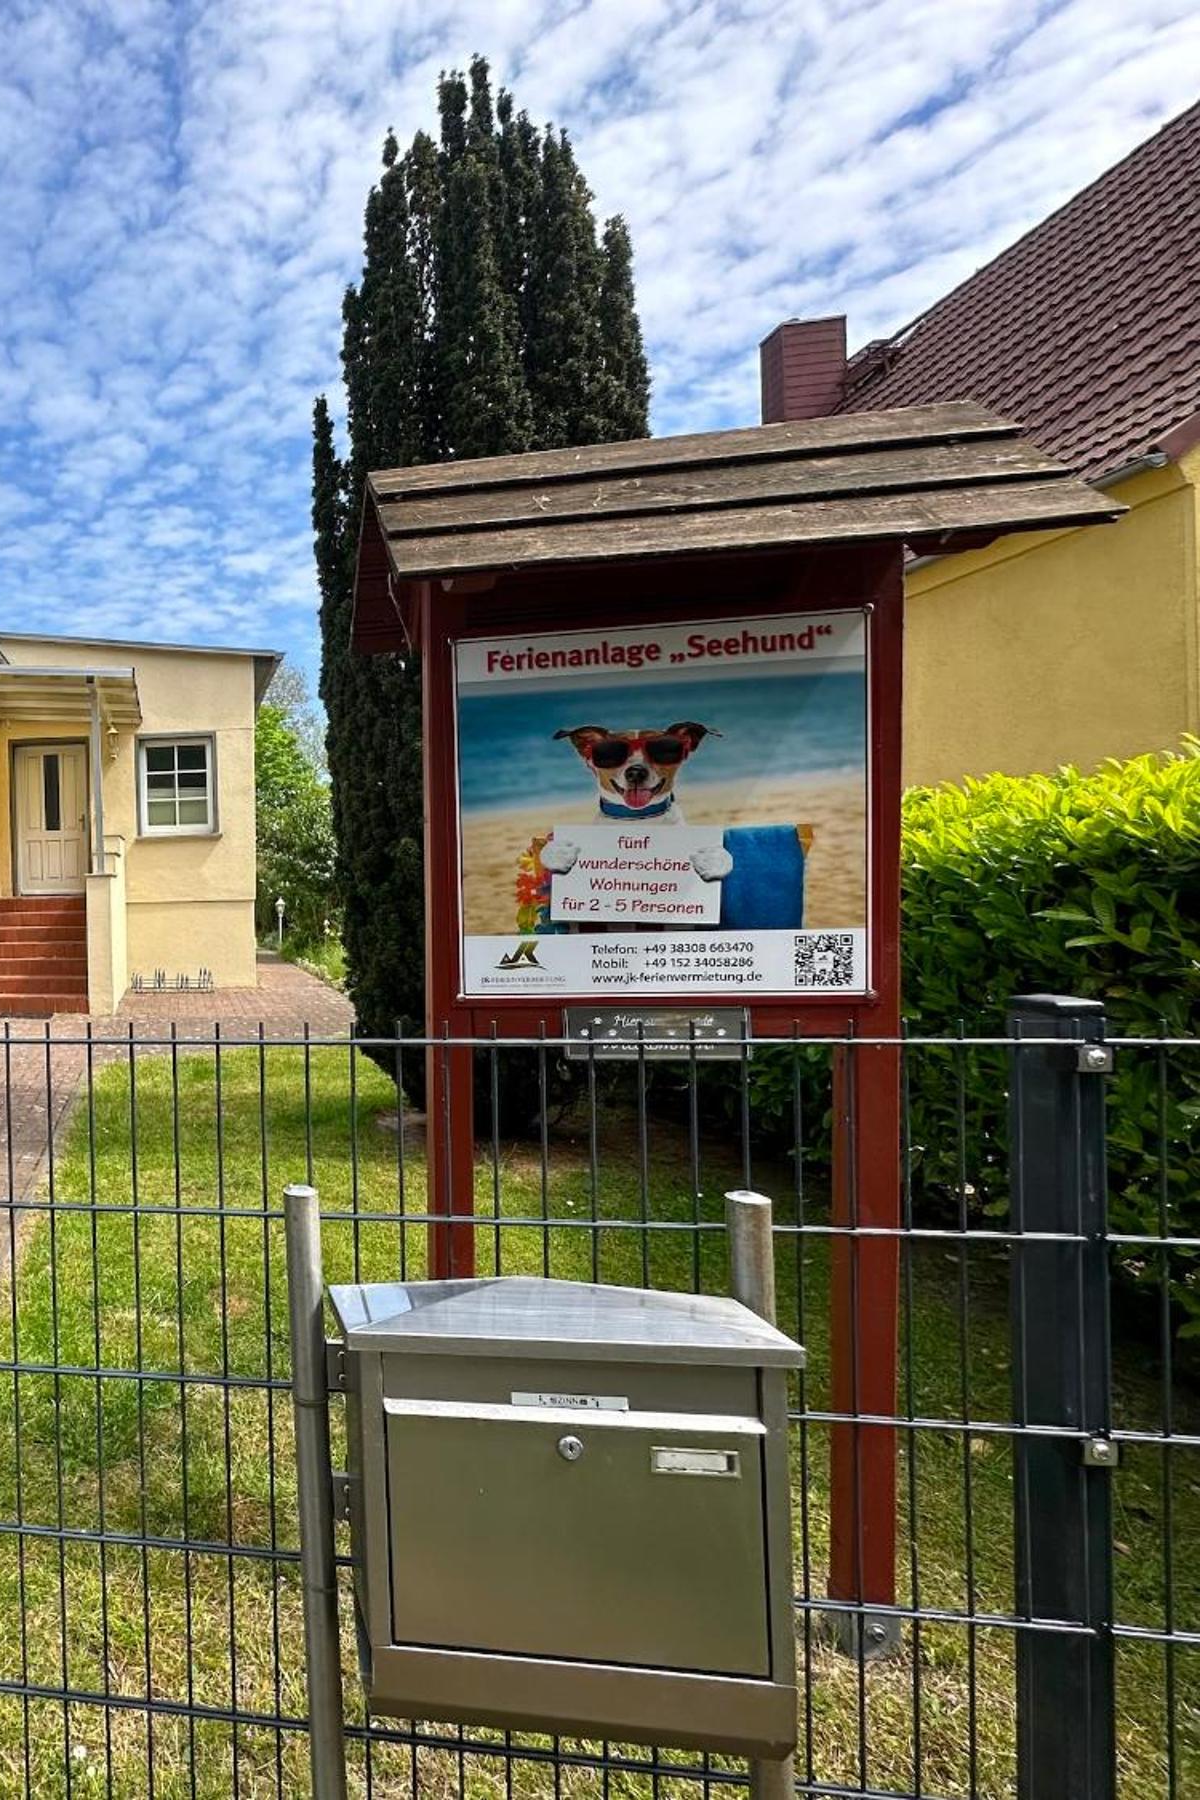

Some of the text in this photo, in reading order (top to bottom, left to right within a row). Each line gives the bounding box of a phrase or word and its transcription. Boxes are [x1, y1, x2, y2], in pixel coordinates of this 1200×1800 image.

[487, 624, 833, 673] Ferienanlage „Seehund“
[617, 835, 651, 850] fünf
[578, 857, 691, 872] wunderschöne
[590, 877, 678, 895] Wohnungen
[562, 897, 585, 911] für
[589, 898, 600, 912] 2
[615, 899, 627, 912] 5
[631, 899, 704, 914] Personen
[591, 942, 754, 955] Telefon: +49 38308 663470
[591, 957, 754, 969] Mobil: +49 152 34058286
[591, 971, 763, 984] www.jk-ferienvermietung.de
